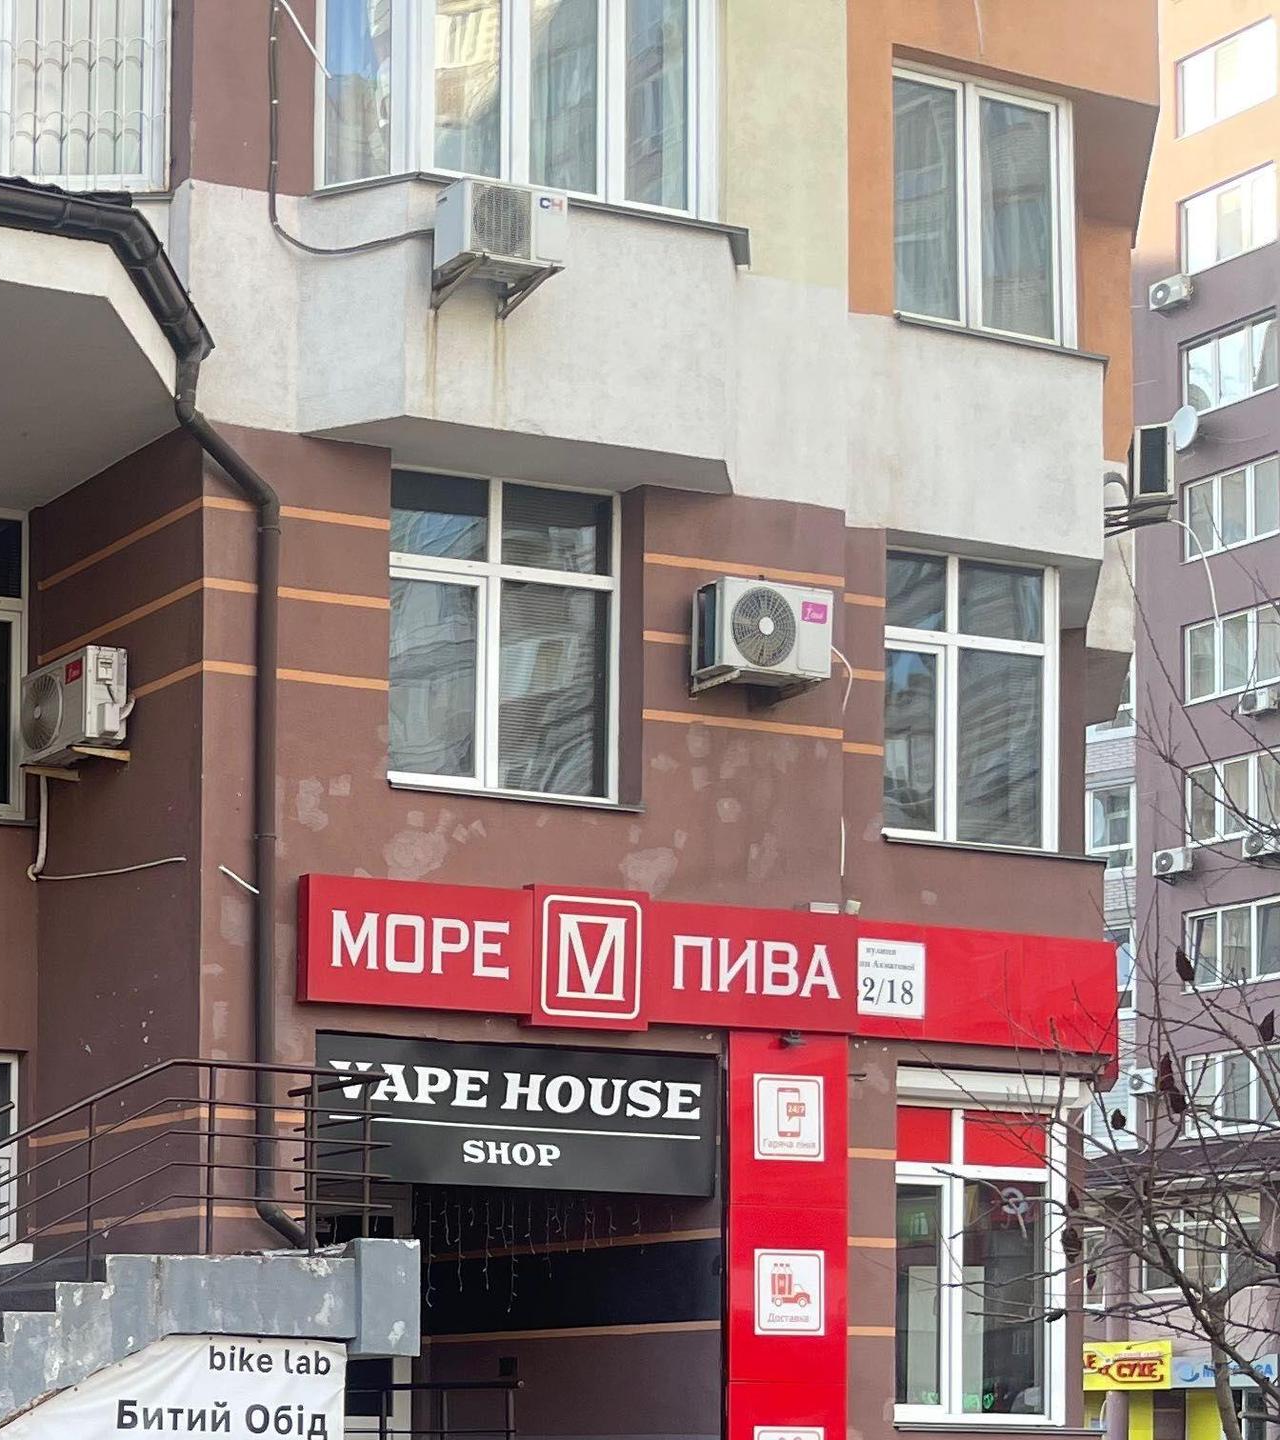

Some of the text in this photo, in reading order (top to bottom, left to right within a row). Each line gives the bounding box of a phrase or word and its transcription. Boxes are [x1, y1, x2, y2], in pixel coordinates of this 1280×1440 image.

[330, 909, 511, 981] МОРЕ
[672, 934, 842, 1001] ПИВА
[857, 976, 914, 1006] 2/18
[501, 1071, 702, 1121] HOUSE
[462, 1139, 562, 1168] SHOP
[768, 1313, 810, 1323] Доставка
[208, 1345, 332, 1377] bike lab
[116, 1398, 232, 1434] Битий
